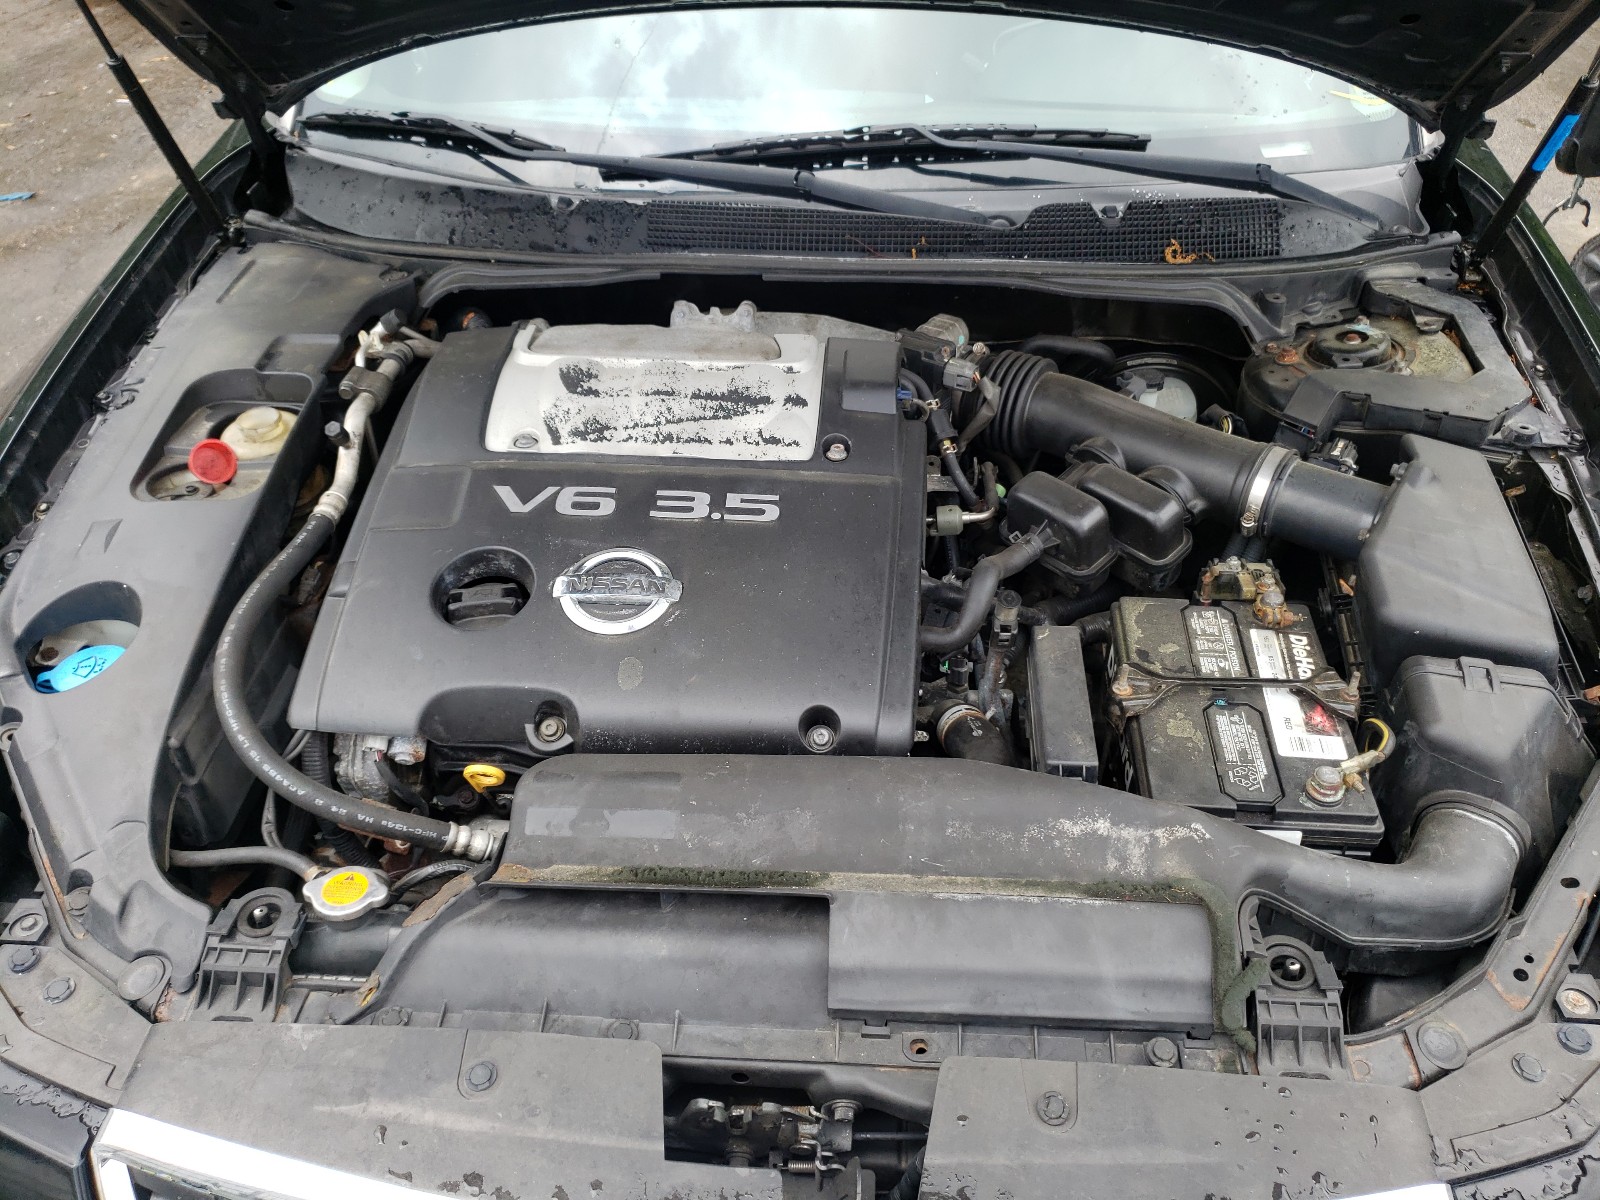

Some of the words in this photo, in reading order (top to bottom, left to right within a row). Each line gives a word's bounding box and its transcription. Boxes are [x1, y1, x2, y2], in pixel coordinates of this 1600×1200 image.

[493, 485, 617, 516] V6
[649, 489, 780, 522] 3.5
[567, 576, 667, 594] NISSAN
[236, 733, 250, 748] LP
